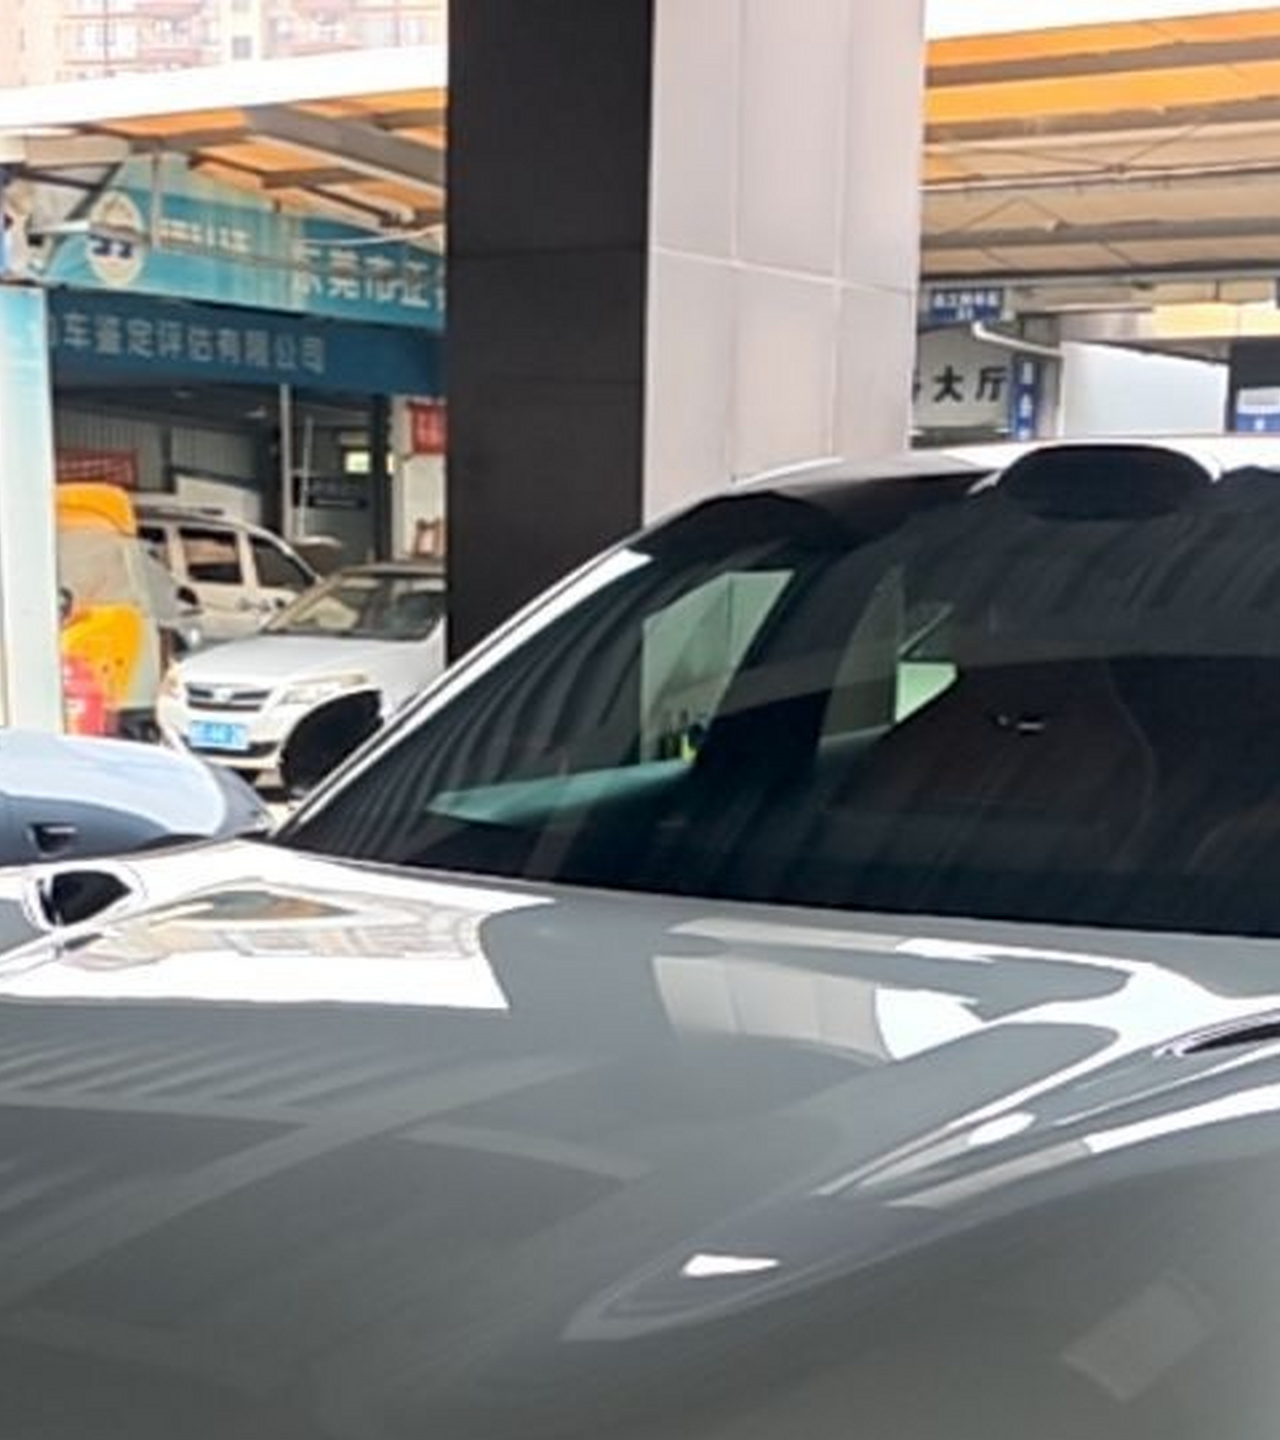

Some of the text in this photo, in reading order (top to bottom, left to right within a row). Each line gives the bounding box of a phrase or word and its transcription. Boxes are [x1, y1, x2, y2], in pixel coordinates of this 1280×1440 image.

[46, 311, 326, 374] 车鉴定评估有限公司
[911, 363, 1007, 403] 大厅
